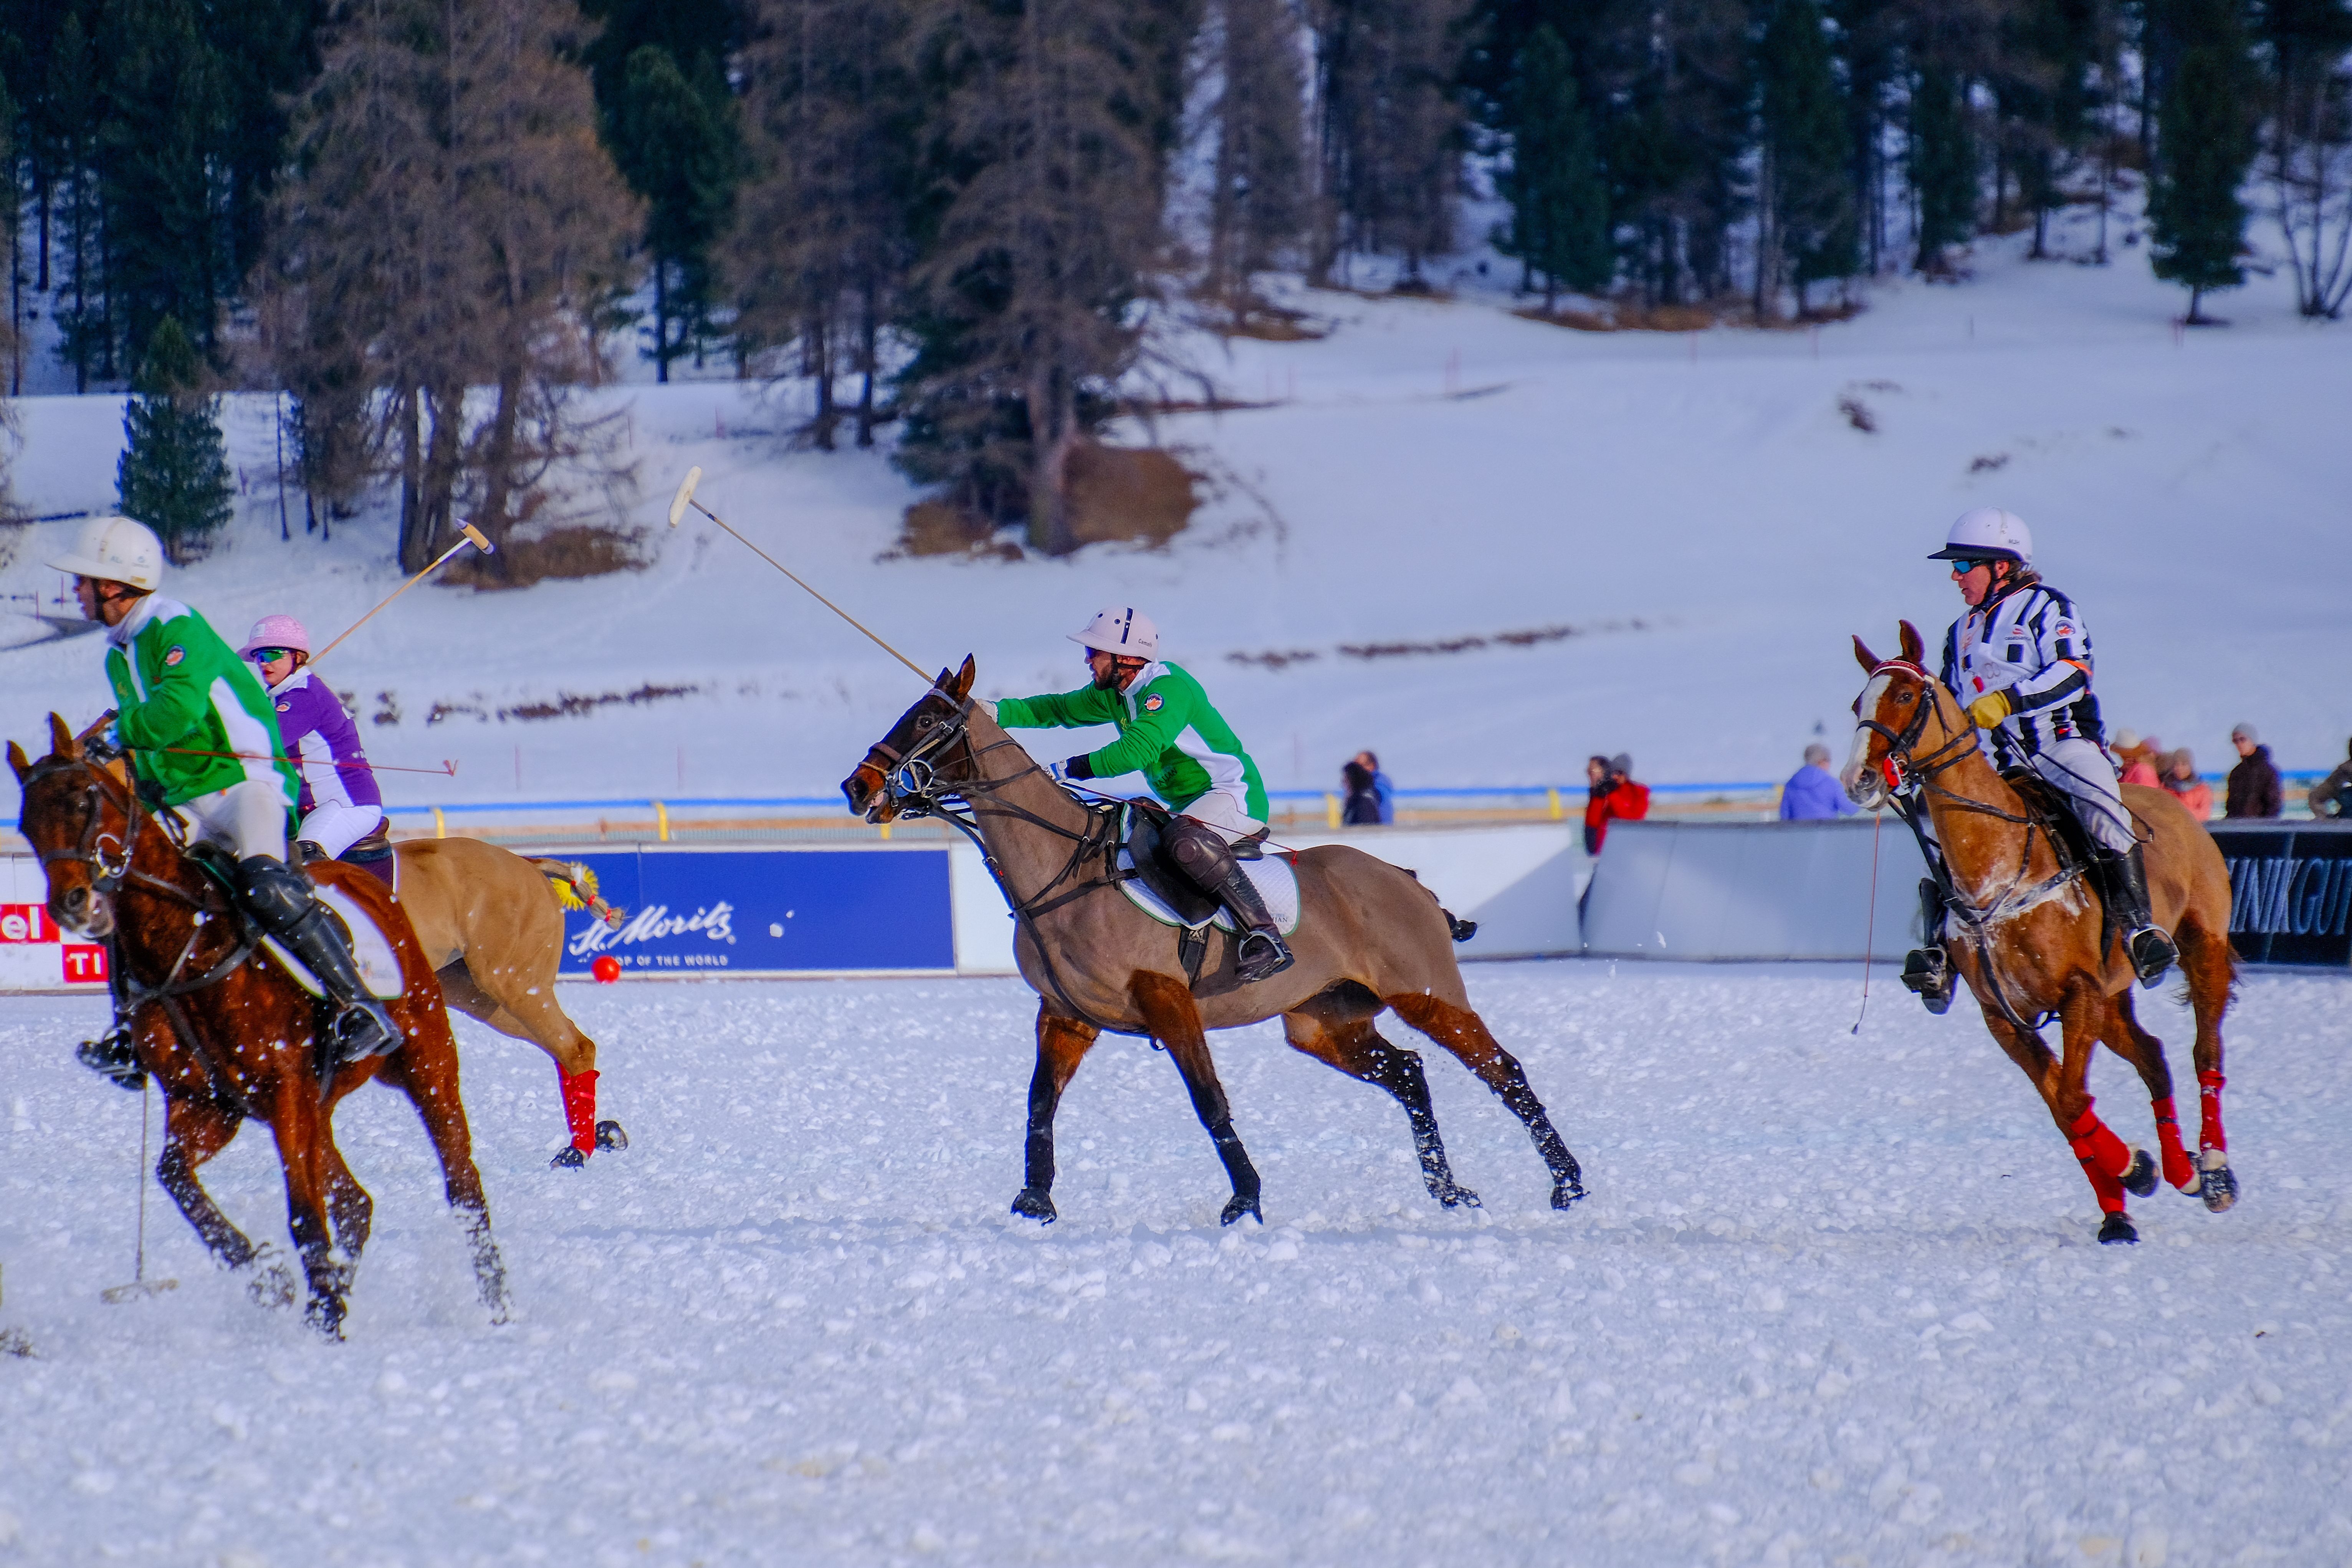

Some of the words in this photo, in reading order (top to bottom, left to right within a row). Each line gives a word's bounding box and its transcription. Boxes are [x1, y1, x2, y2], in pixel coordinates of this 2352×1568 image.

[607, 901, 734, 949] Moritz
[615, 954, 633, 967] OP
[636, 955, 652, 966] OF
[656, 955, 680, 966] THE
[684, 954, 728, 966] WORLD
